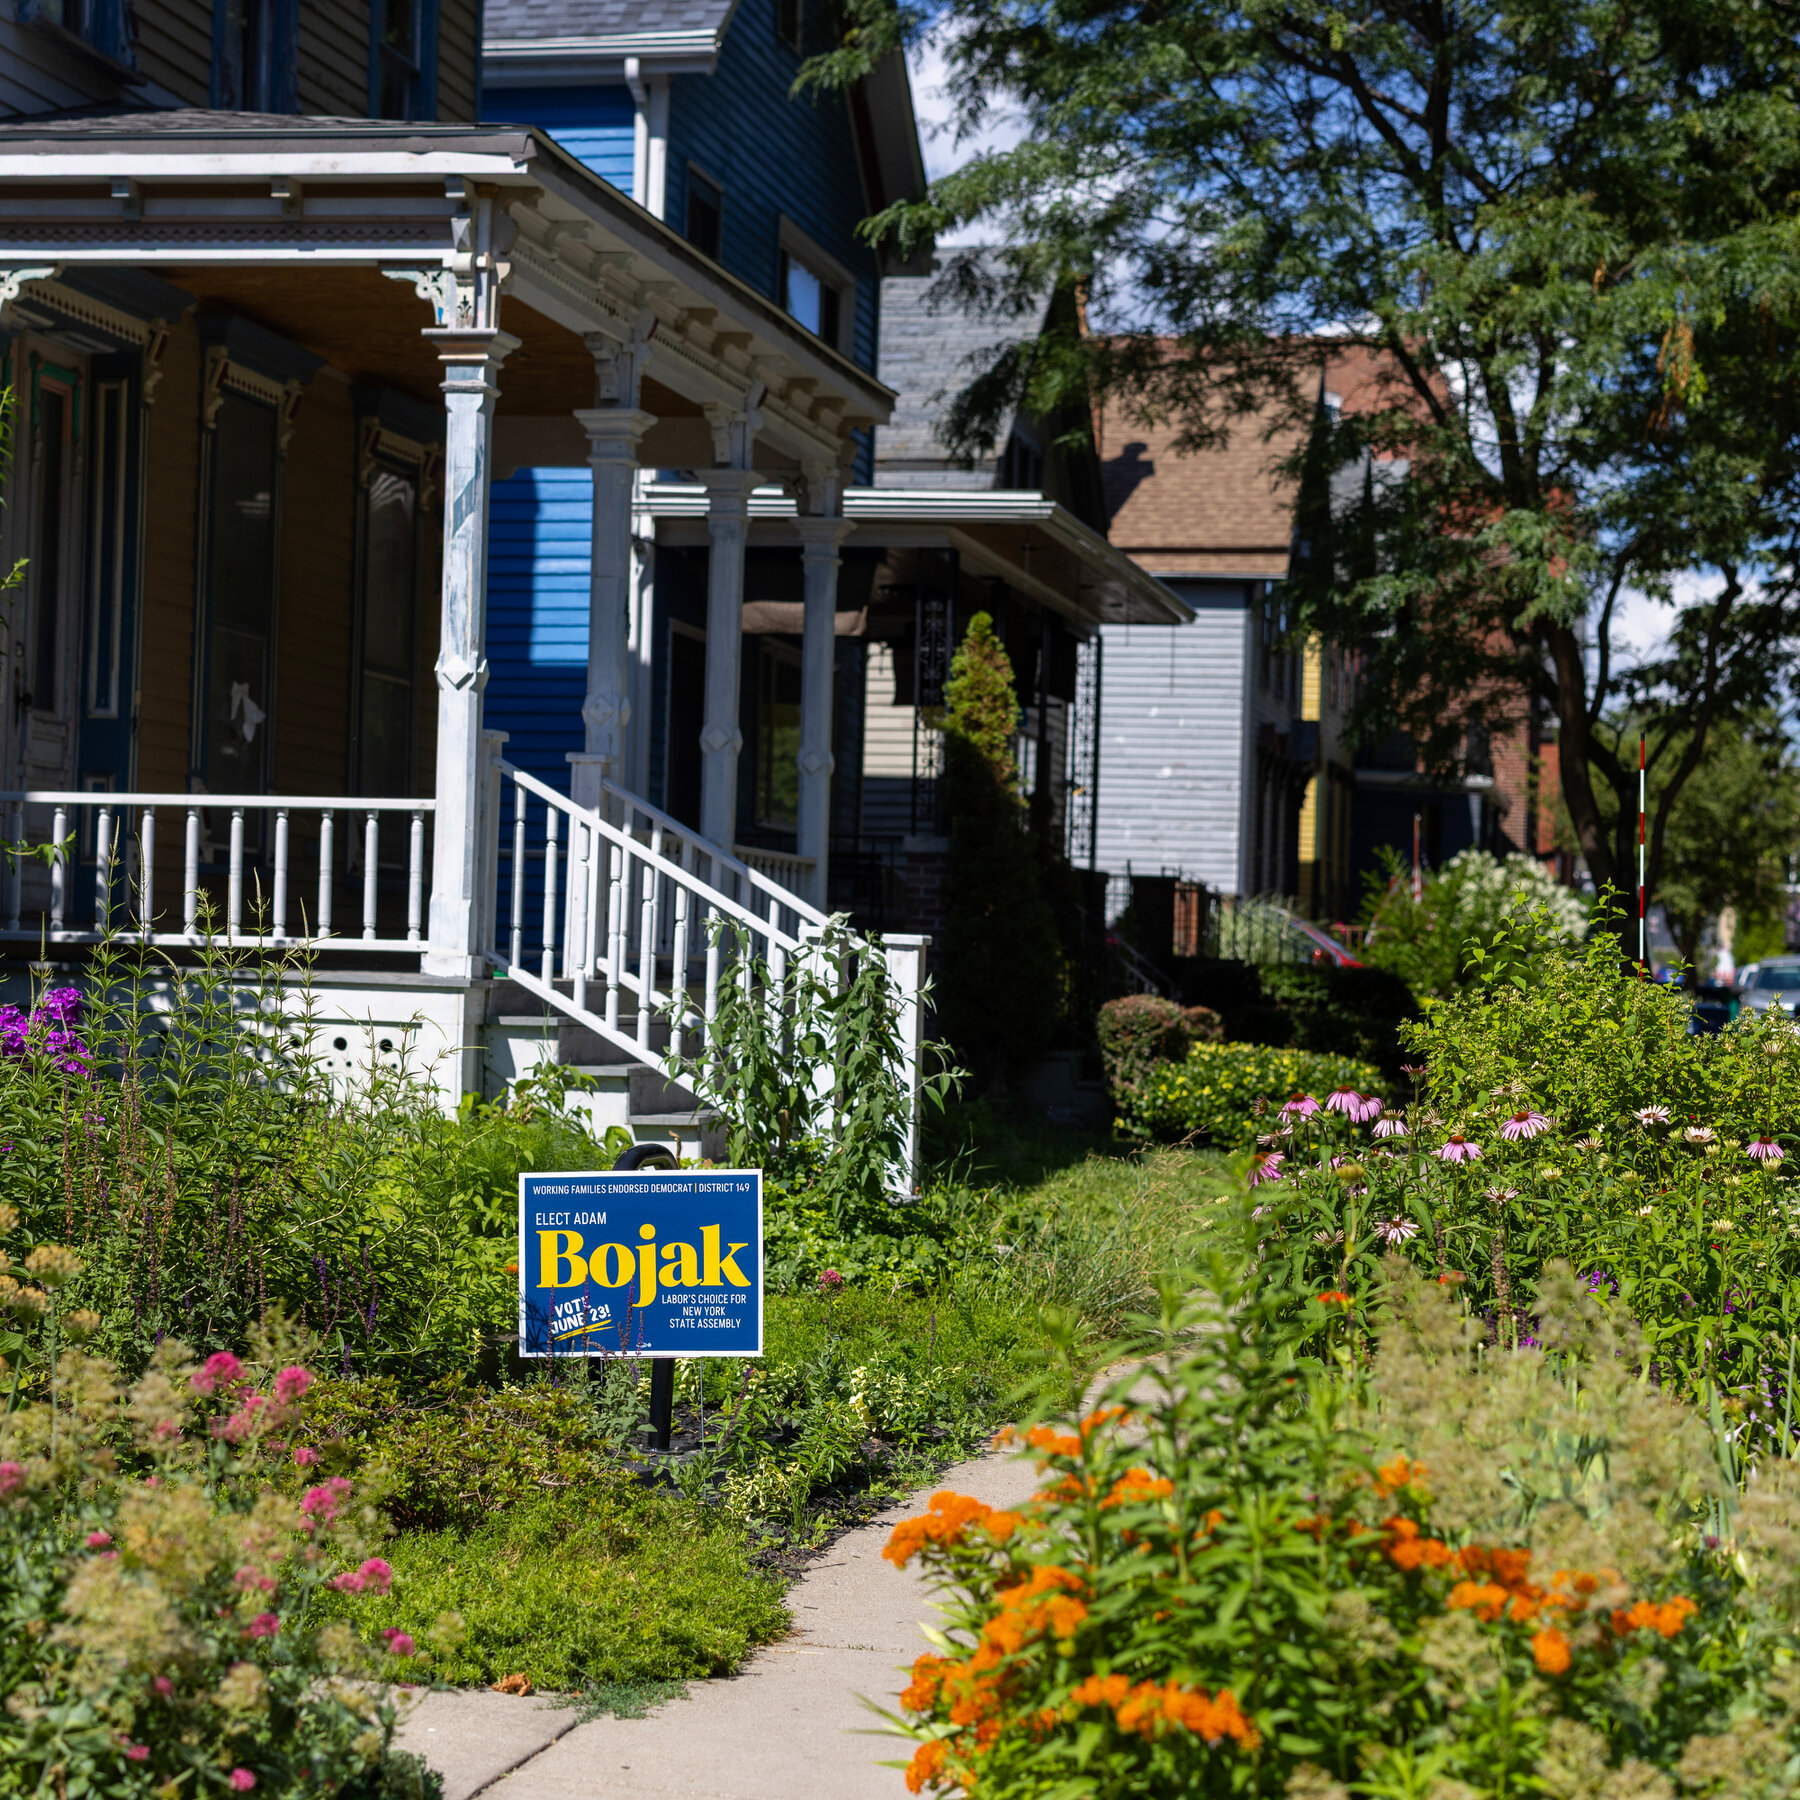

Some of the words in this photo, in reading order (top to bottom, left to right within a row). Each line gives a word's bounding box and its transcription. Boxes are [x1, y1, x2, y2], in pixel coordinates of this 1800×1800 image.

[533, 1185, 570, 1195] WORKING
[571, 1184, 607, 1194] FAMILIES
[608, 1183, 649, 1194] ENDORSED
[651, 1183, 693, 1193] DEMOCRAT
[699, 1182, 734, 1193] DISTRICT
[736, 1182, 750, 1192] 149
[535, 1212, 571, 1226] ELECT
[573, 1211, 607, 1225] ADAM
[536, 1223, 751, 1308] Bojak
[661, 1293, 697, 1304] LABOR'S
[698, 1293, 729, 1304] CHOICE
[730, 1293, 747, 1304] FOR
[589, 1303, 612, 1322] 23!
[682, 1306, 703, 1316] NEW
[704, 1306, 726, 1316] YORK
[669, 1318, 696, 1329] STATE
[697, 1318, 741, 1329] ASSEMBLY
